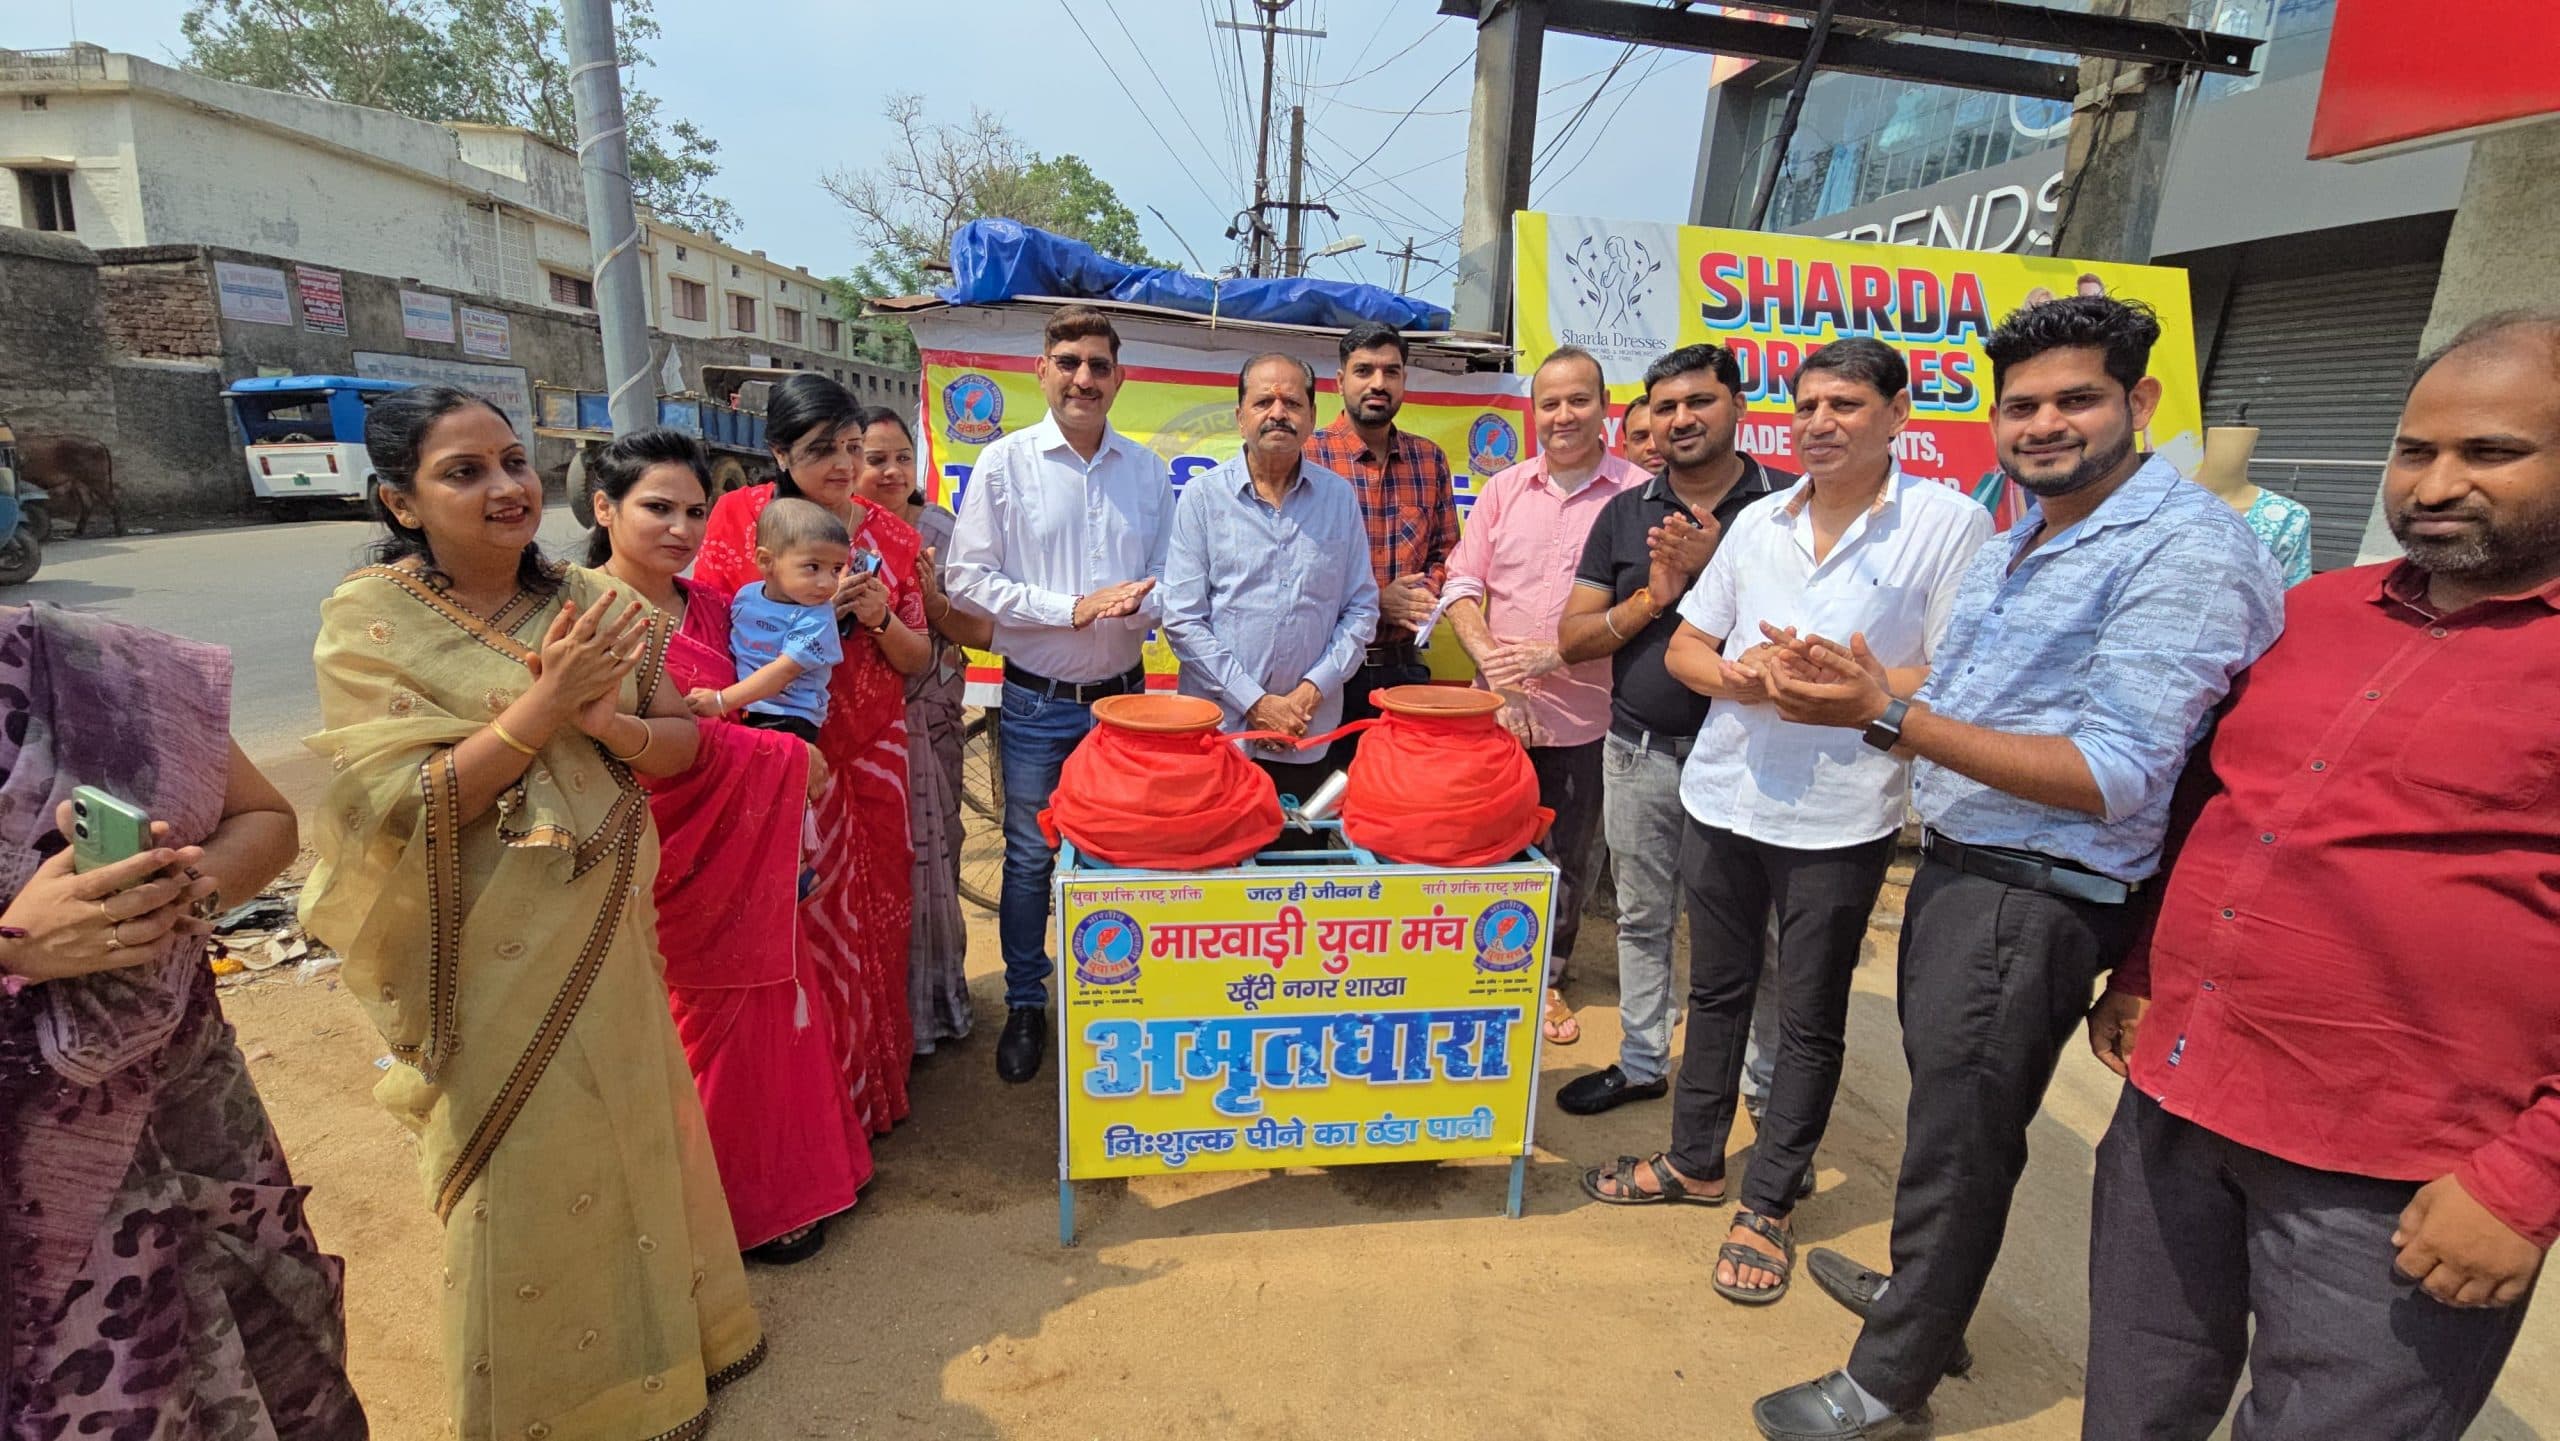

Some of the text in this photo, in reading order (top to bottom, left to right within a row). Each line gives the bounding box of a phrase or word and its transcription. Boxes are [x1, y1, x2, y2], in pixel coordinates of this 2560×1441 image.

[1700, 252, 1994, 343] SHARDA
[1562, 329, 1667, 349] Sharda Dresses
[1725, 337, 1979, 411] DRES
[1072, 889, 1096, 906] युवा
[1102, 887, 1134, 902] शक्ति
[1170, 885, 1202, 900] शक्ति
[1247, 879, 1382, 901] जल ही जीवन है
[1423, 879, 1447, 895] नारी
[1450, 879, 1481, 894] शक्ति
[1512, 878, 1544, 892] शक्ति
[1150, 905, 1307, 969] मारवाड़ी
[1316, 919, 1392, 974] युवा
[1400, 904, 1468, 952] मंच
[1282, 979, 1340, 999] नगर
[1345, 976, 1407, 998] शाखा
[1085, 1007, 1521, 1114] अमृतधारा
[1245, 1117, 1306, 1149] पीने
[1313, 1121, 1358, 1145] का
[1366, 1112, 1420, 1144] ठंडा
[1427, 1106, 1495, 1139] पानी
